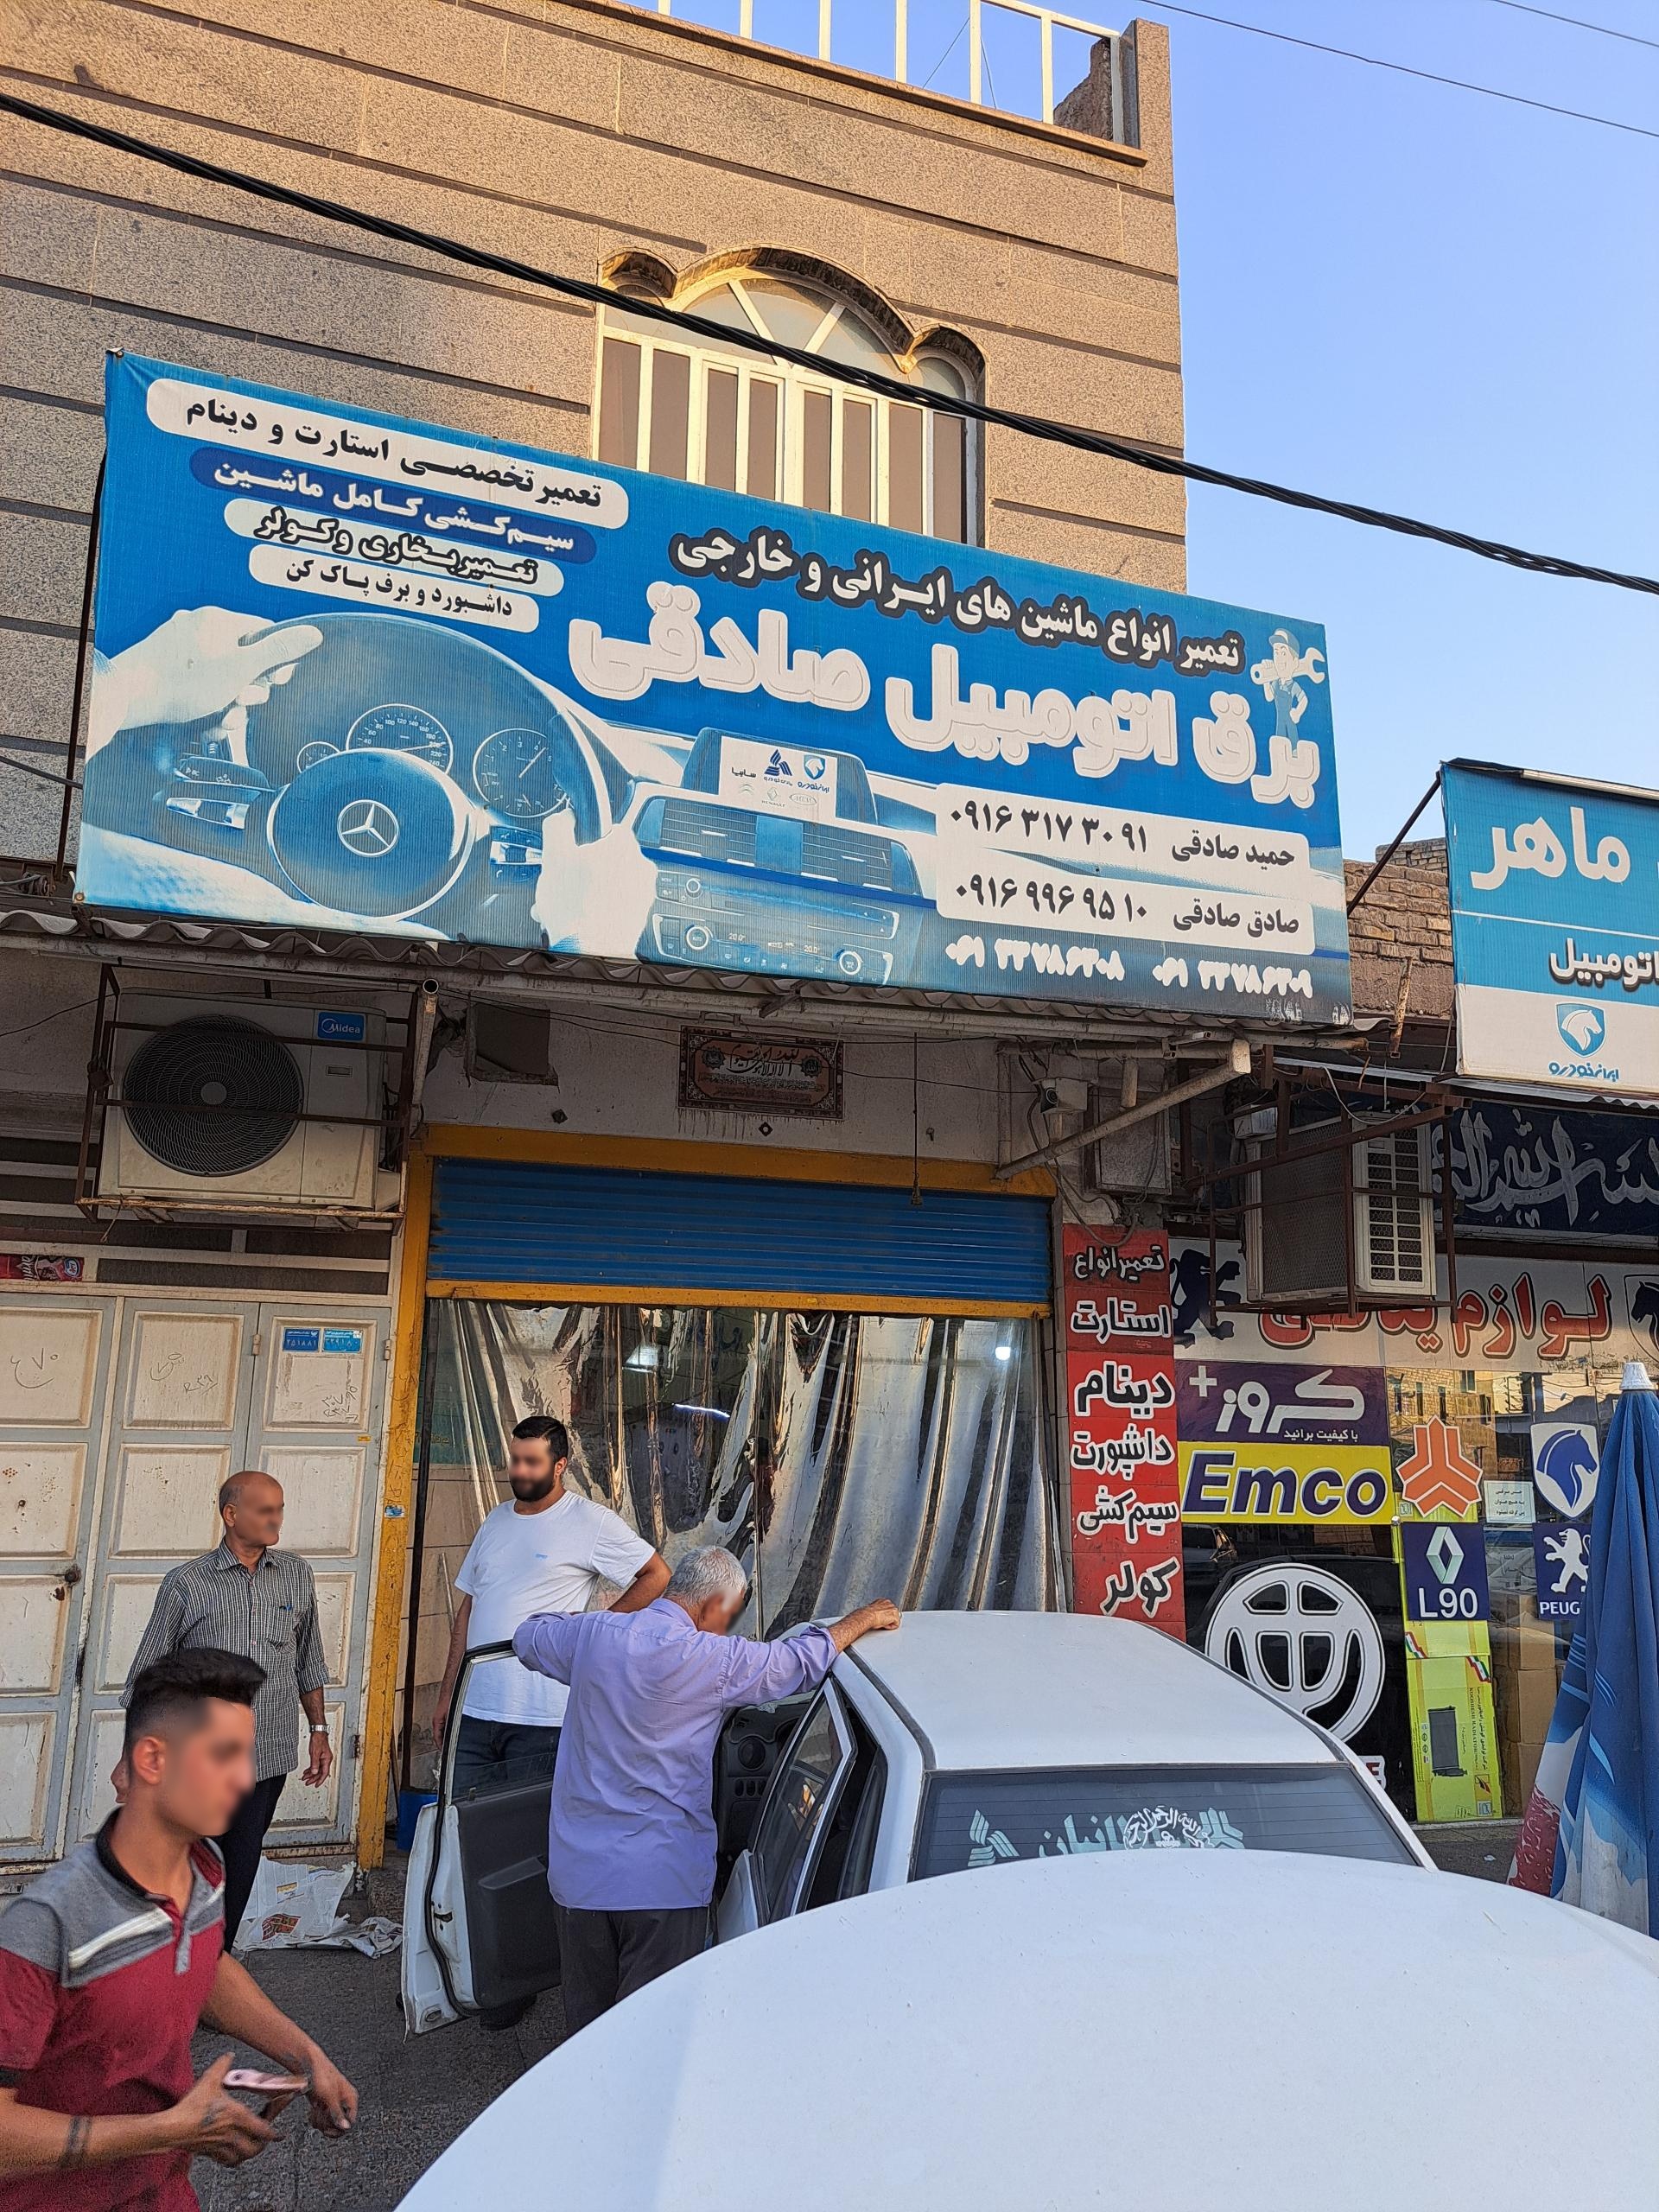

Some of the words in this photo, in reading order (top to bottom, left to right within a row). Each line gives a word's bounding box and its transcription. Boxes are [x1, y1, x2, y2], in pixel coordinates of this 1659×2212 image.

[187, 398, 257, 434] دینام
[267, 423, 284, 445] و
[295, 424, 390, 461] استارت
[214, 461, 324, 499] ماشین
[400, 456, 535, 493] تخصصی
[332, 482, 424, 518] کامل
[535, 484, 601, 507] تعمیر
[253, 505, 339, 544] کولر
[359, 532, 461, 572] بخاری
[459, 552, 539, 585] تعمیر
[677, 534, 794, 580] خارجی
[286, 559, 315, 582] کن
[320, 564, 370, 596] پاک
[374, 572, 410, 602] برف
[804, 561, 822, 592] و
[832, 557, 946, 615] ایرانی
[415, 588, 427, 607] و
[431, 586, 513, 615] داشبورد
[955, 584, 1012, 625] های
[1020, 601, 1098, 640] ماشین
[1107, 615, 1171, 660] انواع
[569, 581, 871, 712] صادقی
[1179, 637, 1240, 670] تعمیر
[885, 643, 1178, 778] اتومبیل
[1192, 690, 1321, 809] برق
[950, 800, 1013, 834] ۰۹۱۶
[1020, 808, 1073, 842] ۳۱۷
[1172, 829, 1240, 862] صادقی
[1245, 844, 1295, 871] حمید
[1471, 806, 1631, 891] ماهر
[956, 874, 1018, 909] ۰۹۱۶
[1026, 880, 1075, 915] ۹۹۶
[1173, 898, 1241, 931] صادقی
[1247, 908, 1300, 938] صادق
[327, 1023, 360, 1034] Midea
[1074, 1244, 1119, 1280] انواع
[1121, 1244, 1166, 1281] تعمیر
[1071, 1296, 1171, 1344] استارت
[1452, 1271, 1613, 1361] لوازم
[1074, 1360, 1176, 1419] دینام
[1215, 1368, 1365, 1433] کروز
[1283, 1428, 1314, 1441] برانید
[1316, 1428, 1349, 1442] کیفیت
[1351, 1430, 1358, 1442] با
[1181, 1450, 1388, 1517] Emco
[1100, 1556, 1180, 1618] کولر
[1418, 1587, 1478, 1618] L90
[1539, 1601, 1580, 1615] PEUG
